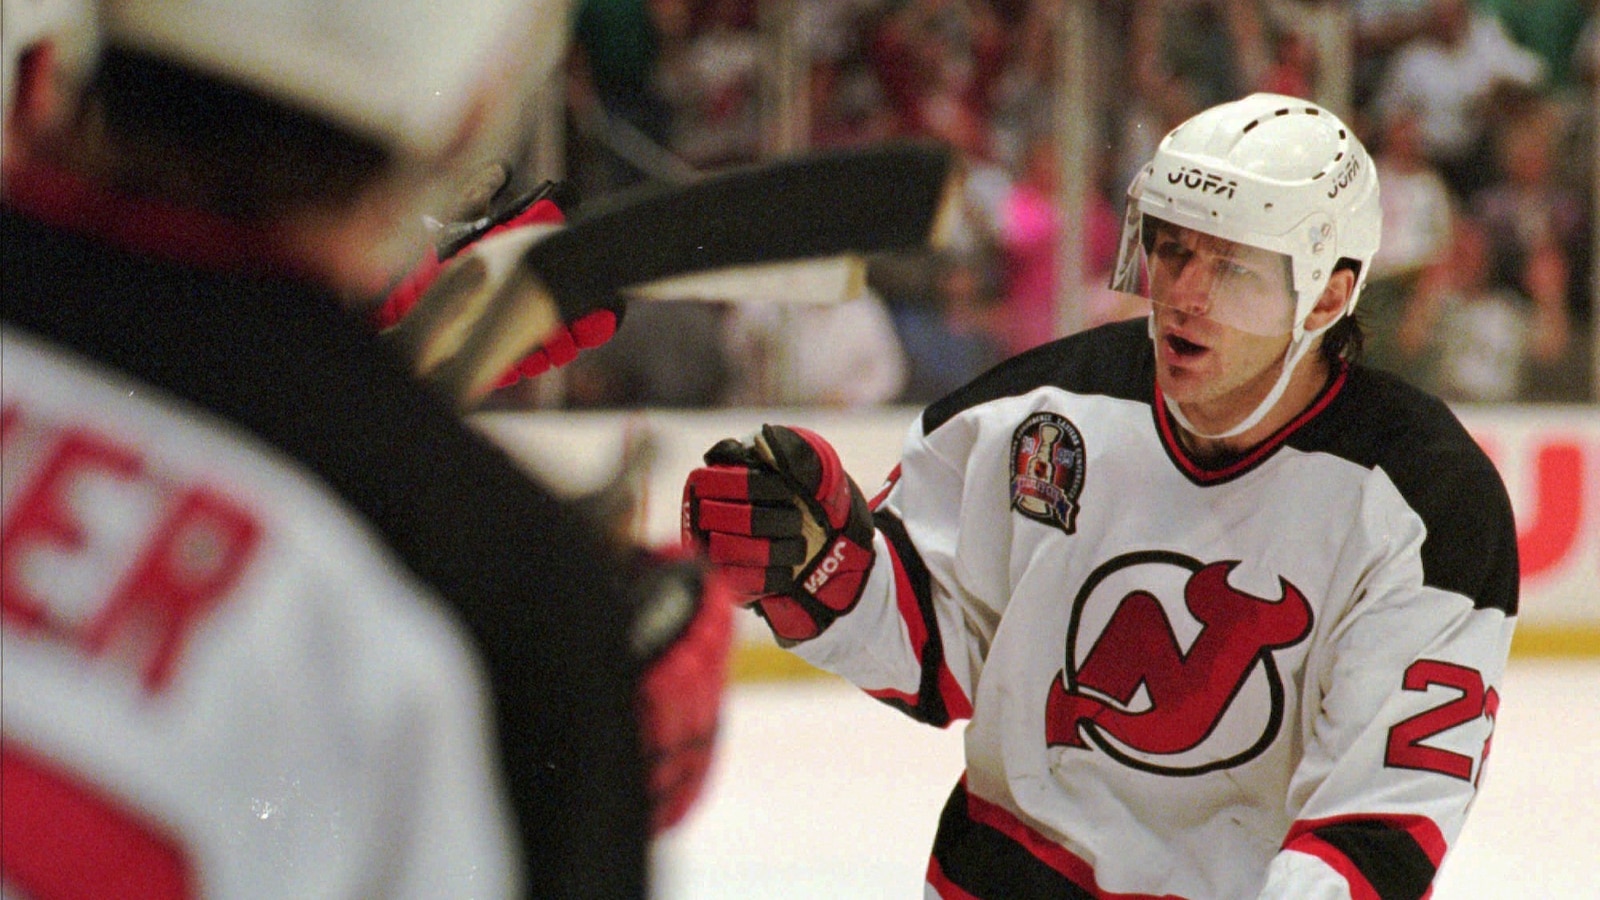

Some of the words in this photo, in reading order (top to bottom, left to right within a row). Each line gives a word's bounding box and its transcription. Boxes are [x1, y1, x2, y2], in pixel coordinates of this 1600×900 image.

[1168, 166, 1238, 200] JOFA
[1327, 154, 1361, 199] JOFA
[0, 400, 265, 700] ER
[803, 541, 846, 594] JOFA
[1384, 659, 1500, 788] 2
